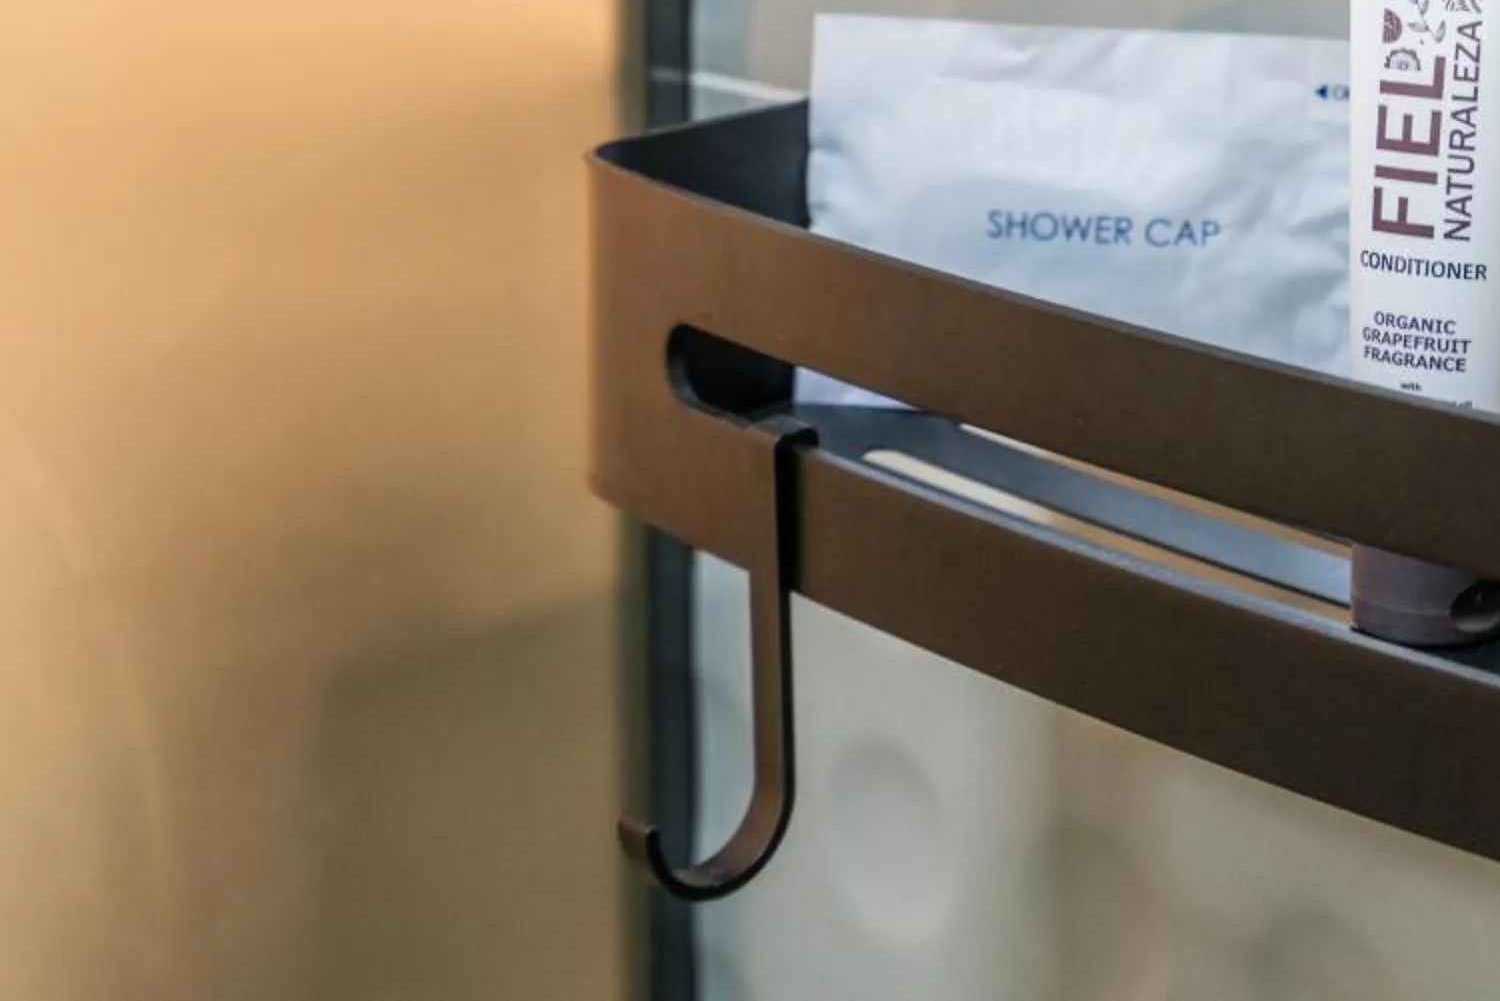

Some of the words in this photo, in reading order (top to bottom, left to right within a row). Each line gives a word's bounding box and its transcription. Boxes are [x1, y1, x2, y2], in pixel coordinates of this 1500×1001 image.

[1443, 21, 1483, 242] NATURALEZA
[1371, 55, 1446, 240] FIEL
[986, 209, 1133, 246] SHOWER
[1144, 218, 1221, 248] CAP
[1360, 249, 1487, 280] CONDITIONER
[1373, 310, 1456, 335] ORGANIC
[1362, 326, 1472, 354] GRAPEFRUIT
[1363, 345, 1467, 372] FRAGRANCE
